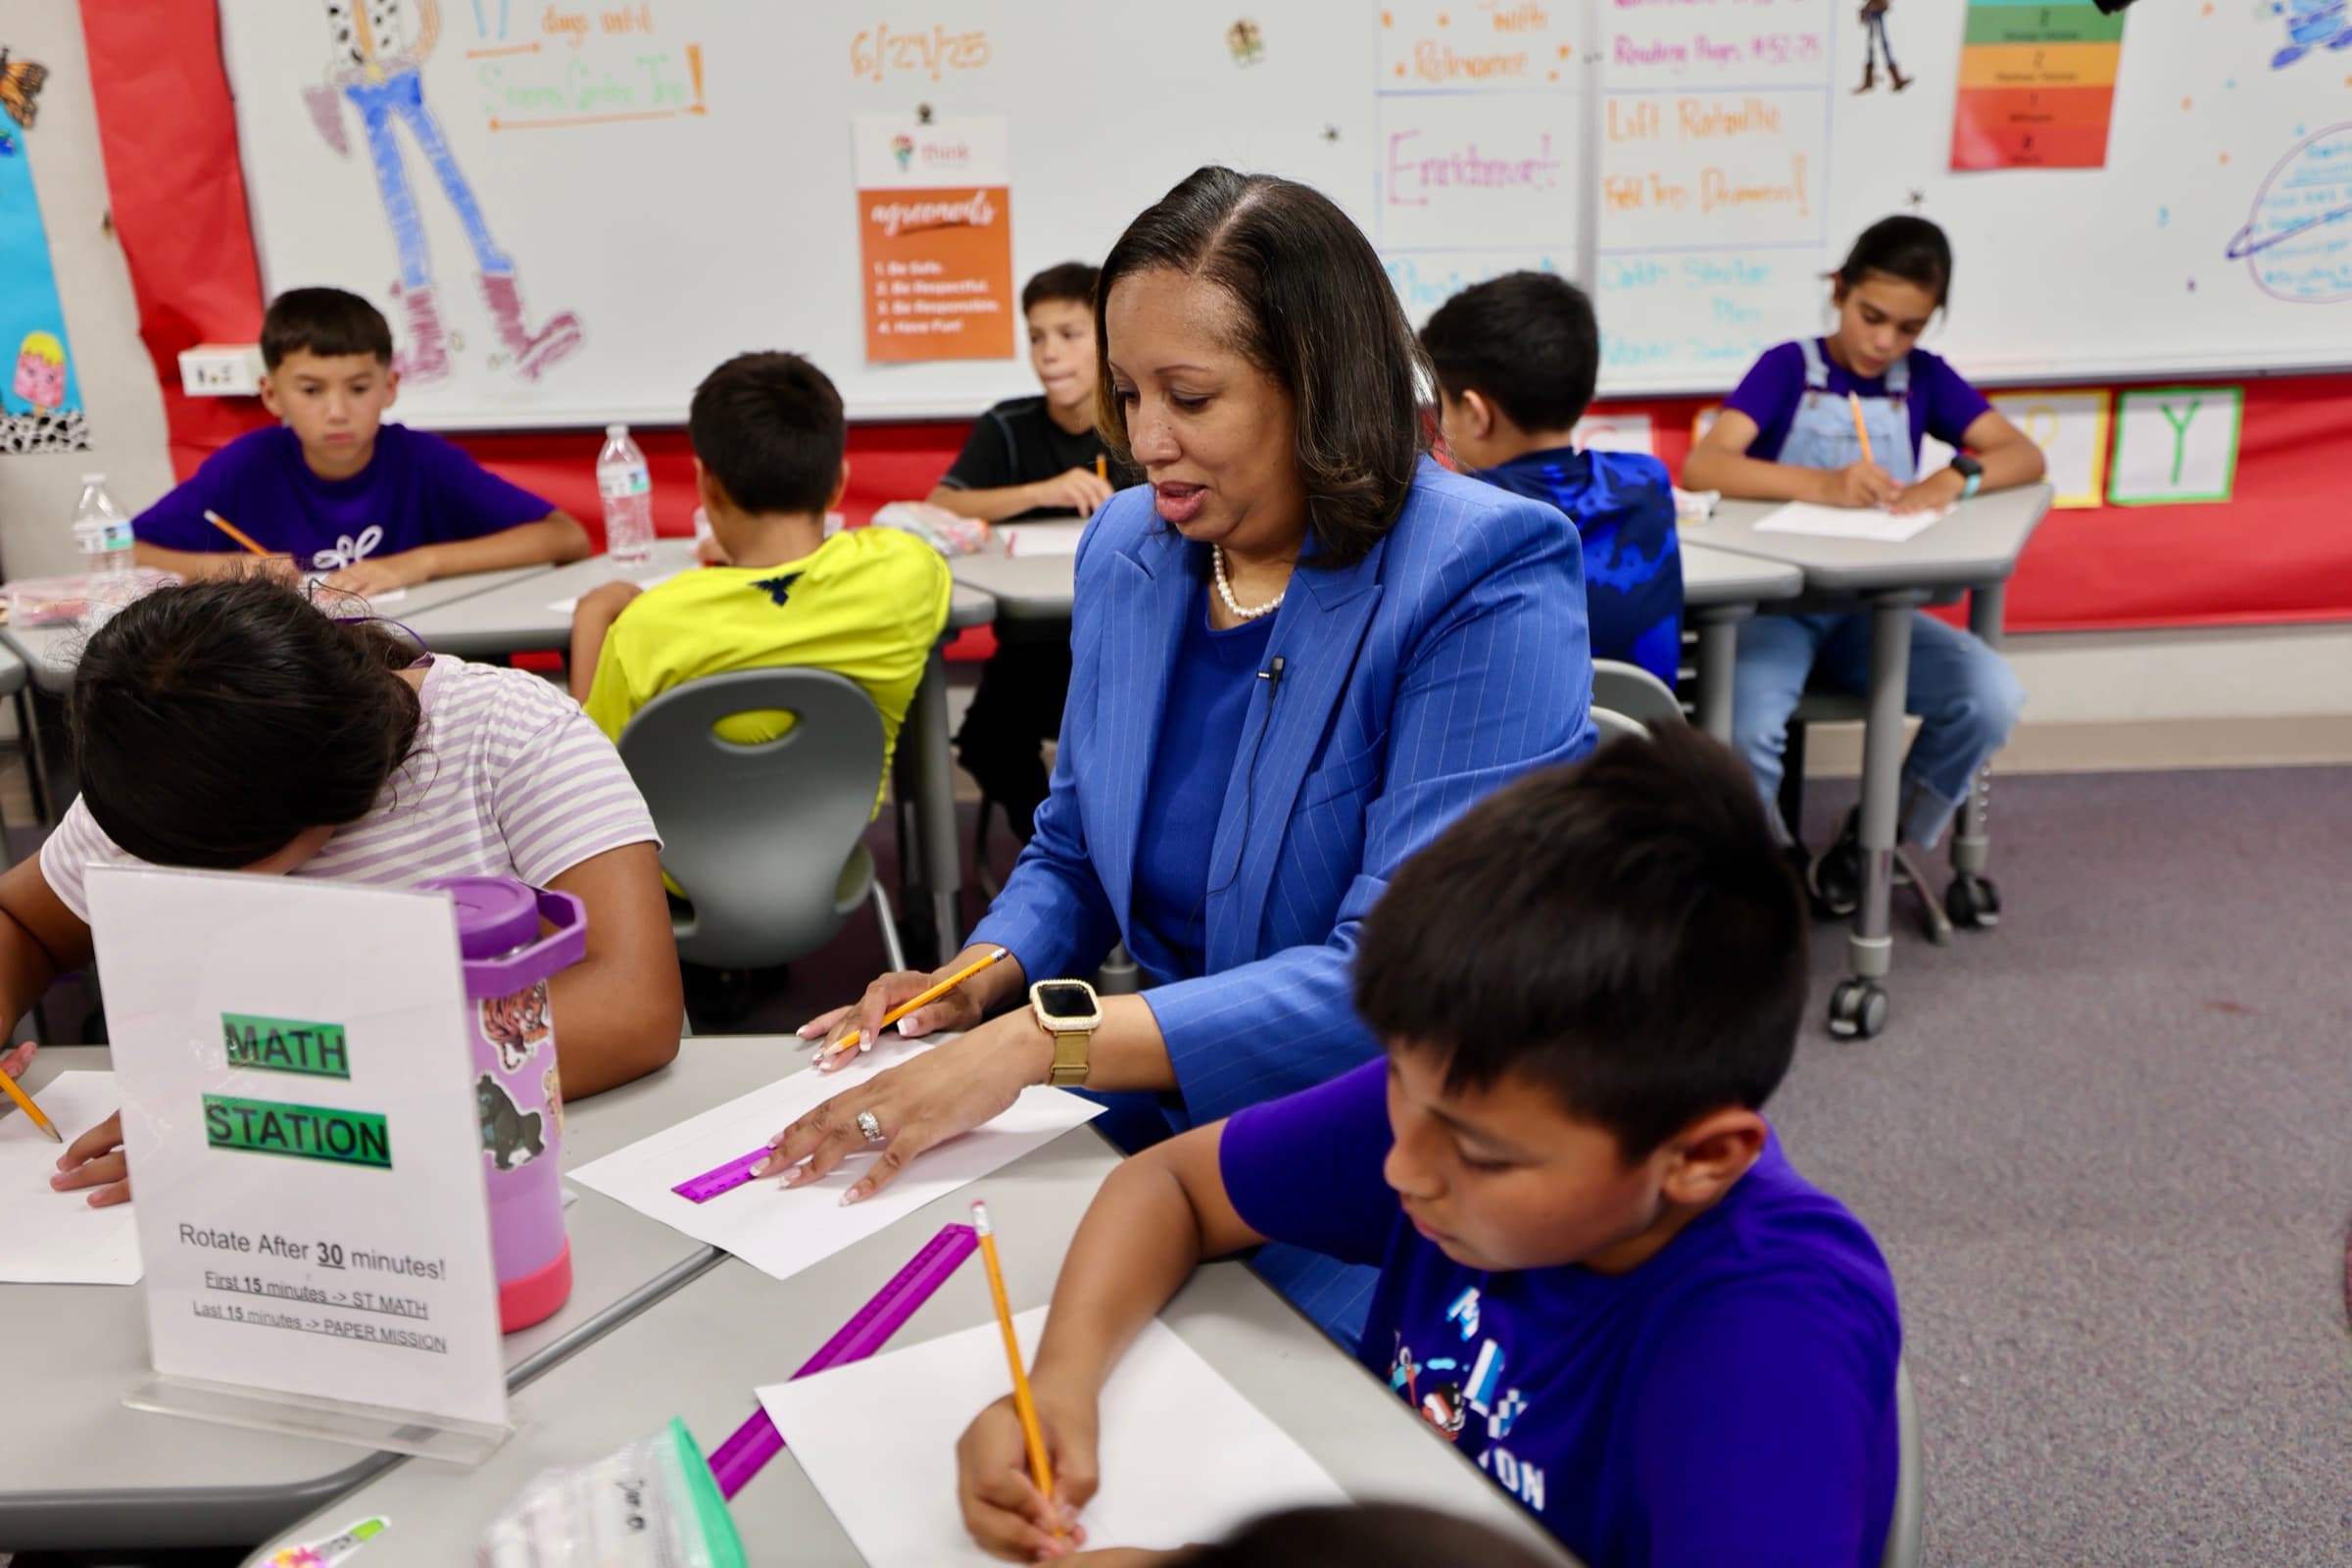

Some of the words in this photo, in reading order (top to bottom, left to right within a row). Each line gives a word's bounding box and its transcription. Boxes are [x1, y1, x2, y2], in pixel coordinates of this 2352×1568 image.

[2160, 399, 2202, 484] Y
[224, 1023, 347, 1071] MATH
[206, 1103, 387, 1160] STATION
[179, 1223, 250, 1251] Rotate
[258, 1234, 309, 1259] After
[317, 1242, 344, 1266] 30
[351, 1249, 445, 1280] minutes!
[205, 1271, 238, 1290] First
[243, 1277, 262, 1293] 15
[266, 1282, 326, 1302] minutes
[352, 1292, 373, 1309] ST
[379, 1297, 428, 1318] MATH
[193, 1301, 221, 1318] Last
[227, 1306, 243, 1320] 15
[247, 1310, 300, 1328] minutes
[324, 1319, 375, 1340] PAPER
[380, 1327, 446, 1352] MISSION
